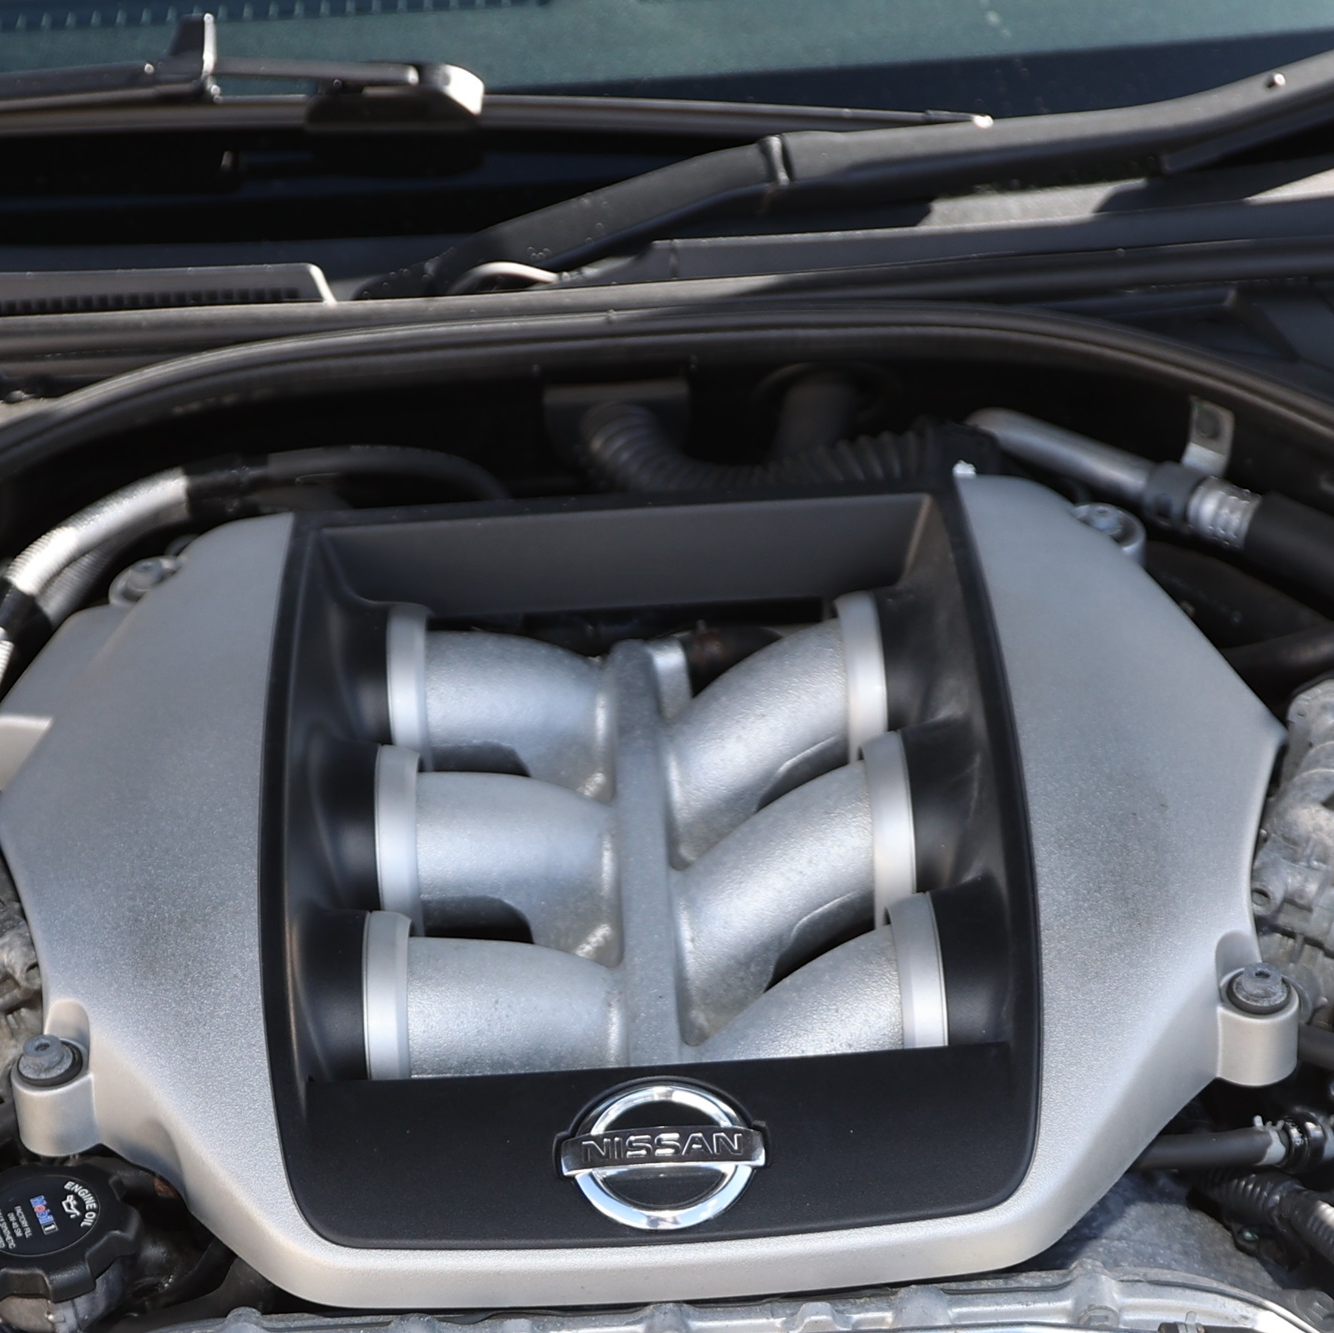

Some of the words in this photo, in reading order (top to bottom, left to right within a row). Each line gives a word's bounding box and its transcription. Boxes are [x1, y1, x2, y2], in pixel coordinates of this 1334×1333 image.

[581, 1132, 744, 1162] NISSAN
[30, 1195, 54, 1225] Mobil
[64, 1181, 96, 1210] ENGINE
[80, 1211, 96, 1227] OIL
